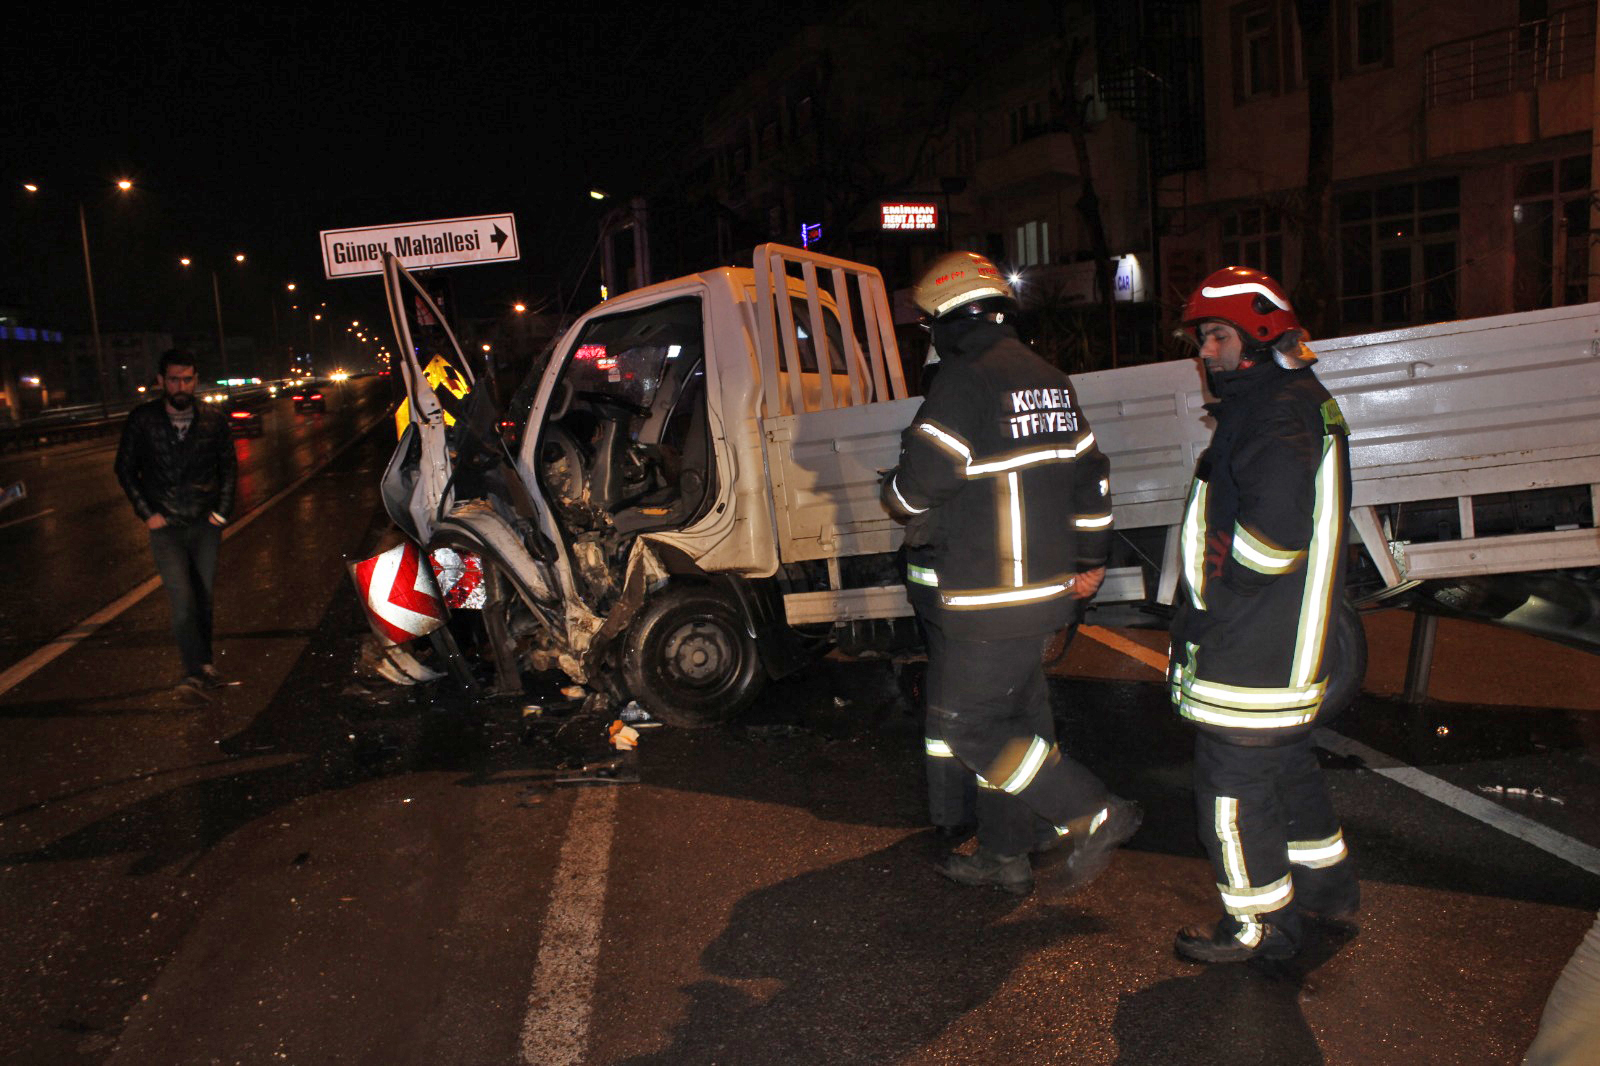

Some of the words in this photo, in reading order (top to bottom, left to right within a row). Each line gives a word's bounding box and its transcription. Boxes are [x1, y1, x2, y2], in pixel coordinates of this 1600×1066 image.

[885, 215, 907, 223] RENT
[908, 215, 914, 223] A
[916, 215, 933, 223] CAR
[394, 230, 480, 258] Mahallesi
[1118, 275, 1130, 290] CAR
